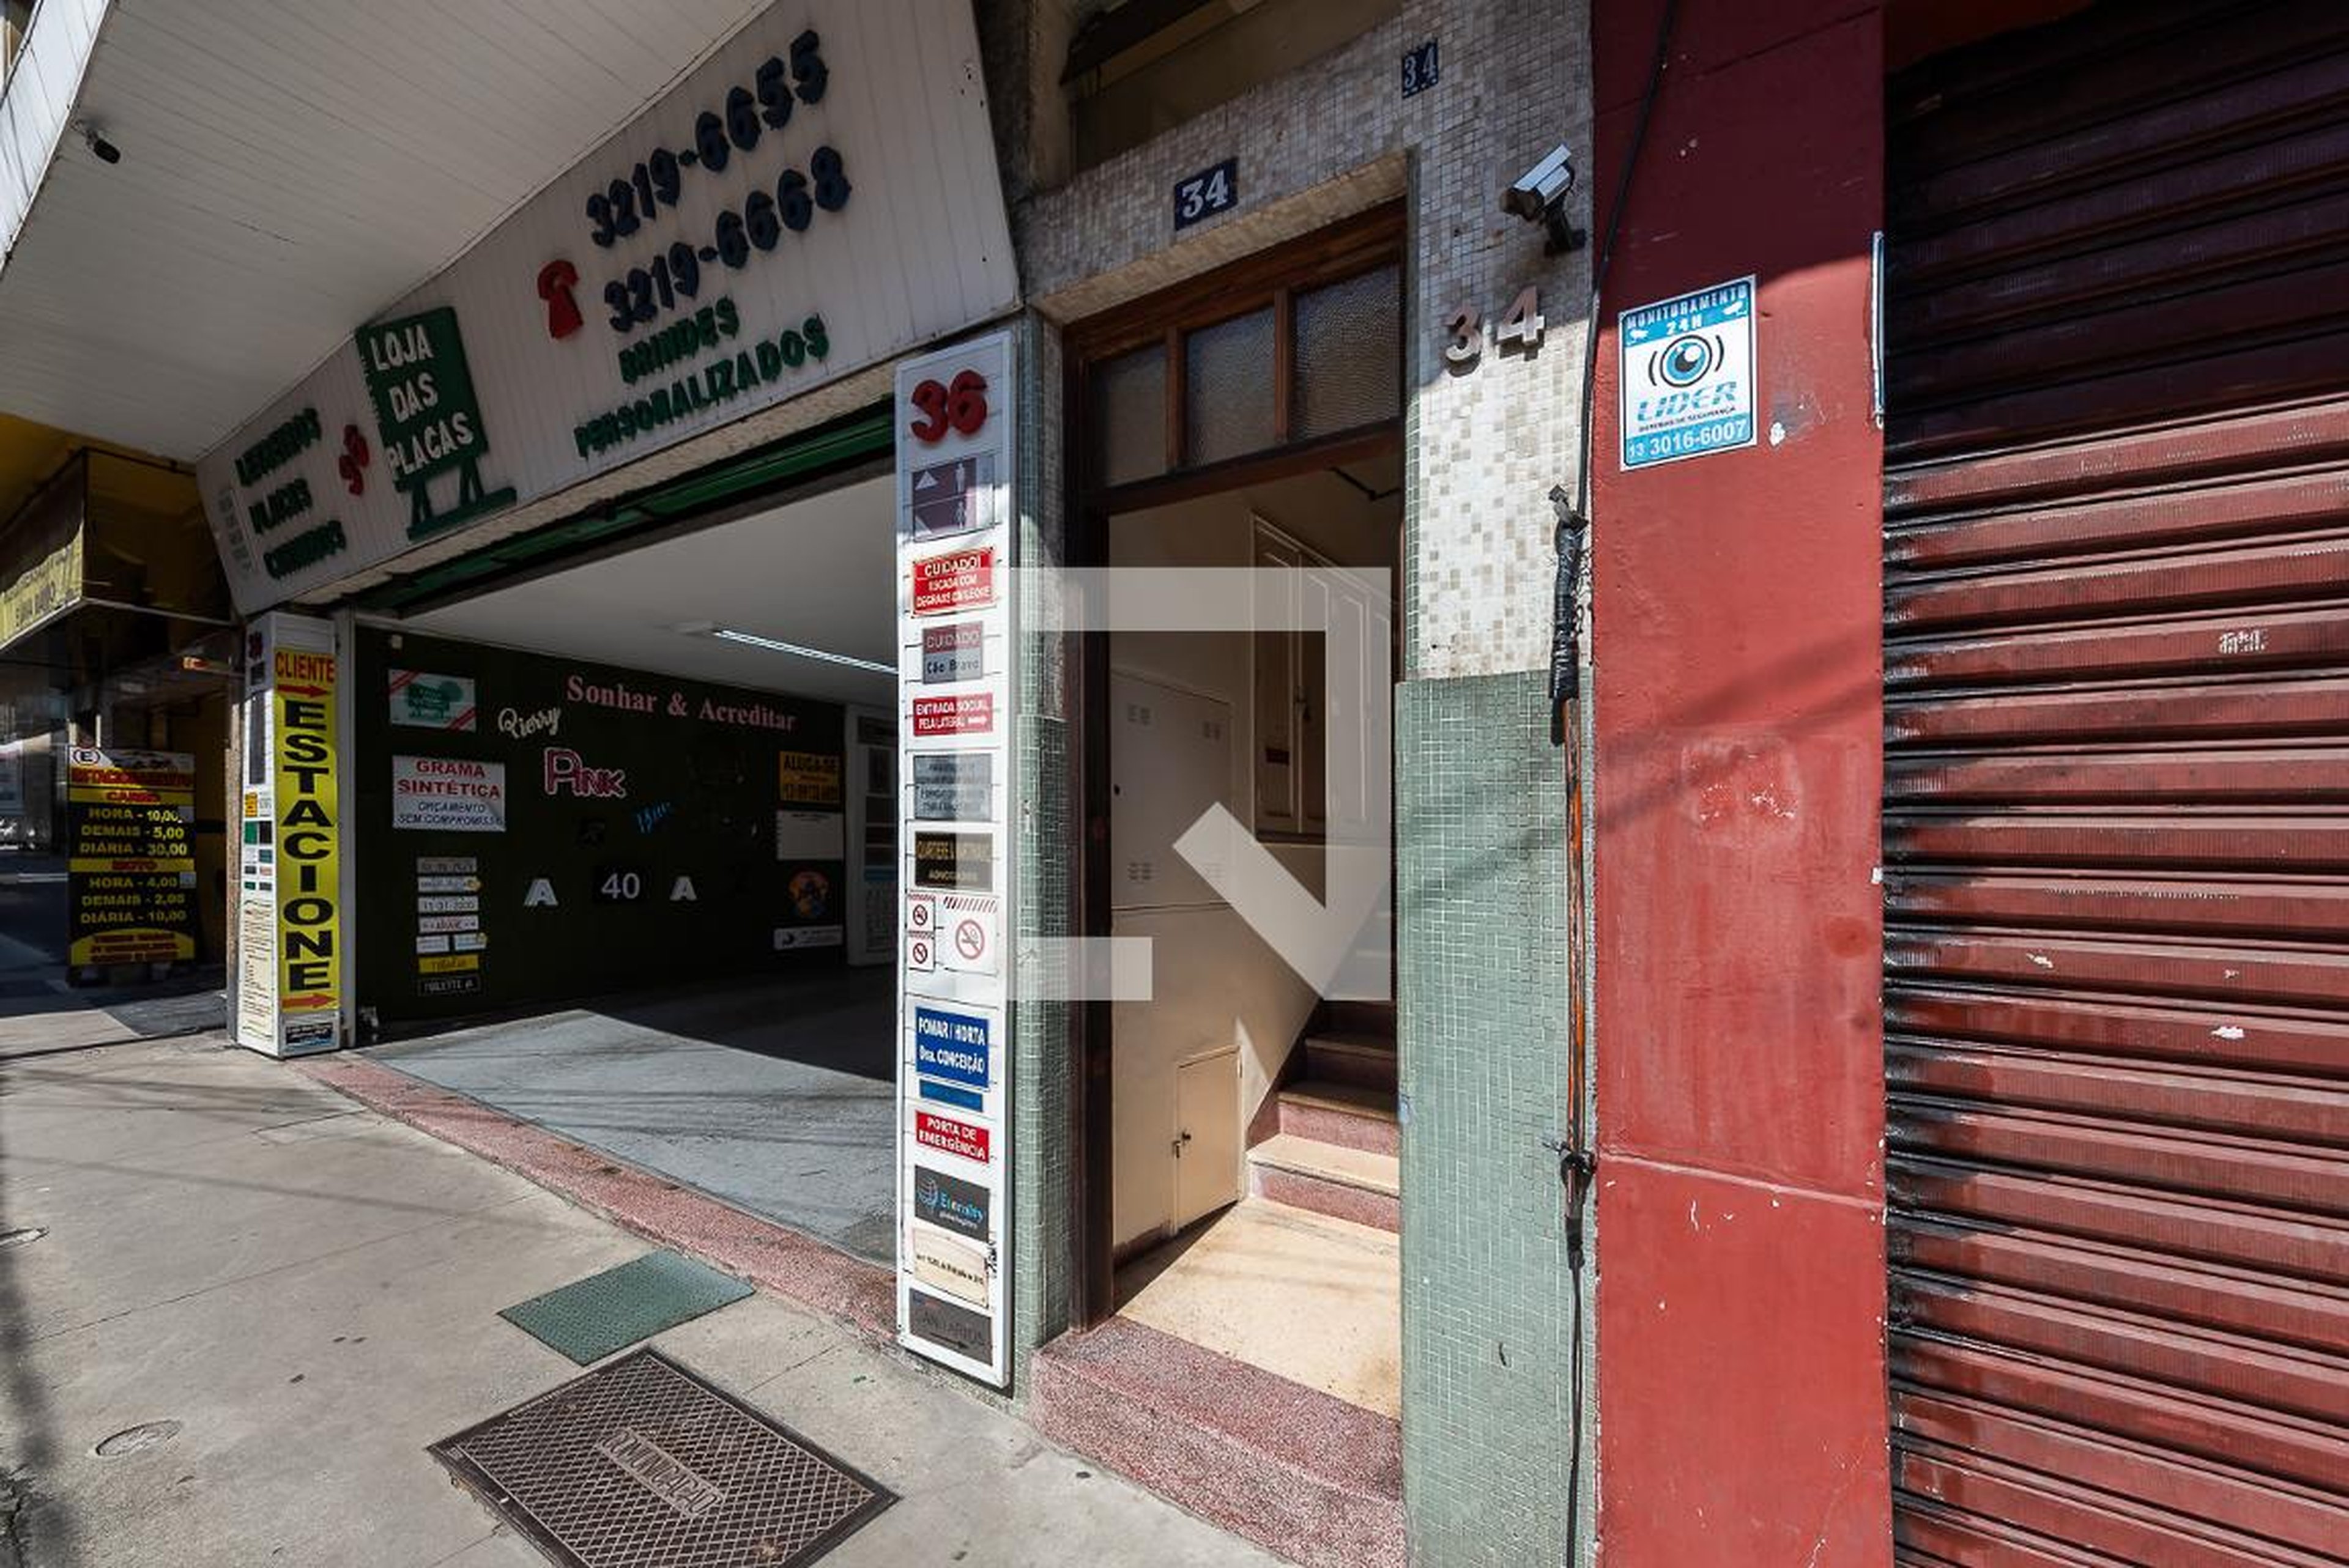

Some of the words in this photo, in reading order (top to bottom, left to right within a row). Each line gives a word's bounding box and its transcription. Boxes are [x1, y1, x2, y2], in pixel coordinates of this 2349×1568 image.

[1403, 46, 1436, 89] 34
[585, 29, 829, 248] 3219-6655
[1181, 171, 1228, 220] 34
[603, 145, 852, 333] 3219-6668
[1627, 284, 1748, 330] MONITORAMENTO
[1666, 315, 1703, 336] 24H
[369, 324, 434, 371] LOJA
[388, 372, 439, 423] DAS
[573, 314, 830, 460] PERSONALIZADOS
[910, 369, 987, 443] 36
[385, 412, 474, 479] PLACAS
[1629, 442, 1646, 458] 13
[1649, 420, 1747, 456] 3016-6007
[926, 631, 980, 649] CUIDADO
[275, 651, 335, 684] CLIENTE
[566, 675, 658, 714] Sonhar
[667, 692, 688, 717] &
[699, 697, 796, 733] Acreditar
[398, 778, 500, 799] SINTÉTICA
[416, 760, 486, 778] GRAMA
[81, 826, 141, 837] DEMAIS
[152, 826, 185, 841] 5,00
[283, 700, 334, 992] ESTACIONE
[524, 878, 558, 907] A
[601, 873, 640, 900] 40
[670, 876, 697, 901] A
[962, 1126, 978, 1141] DE
